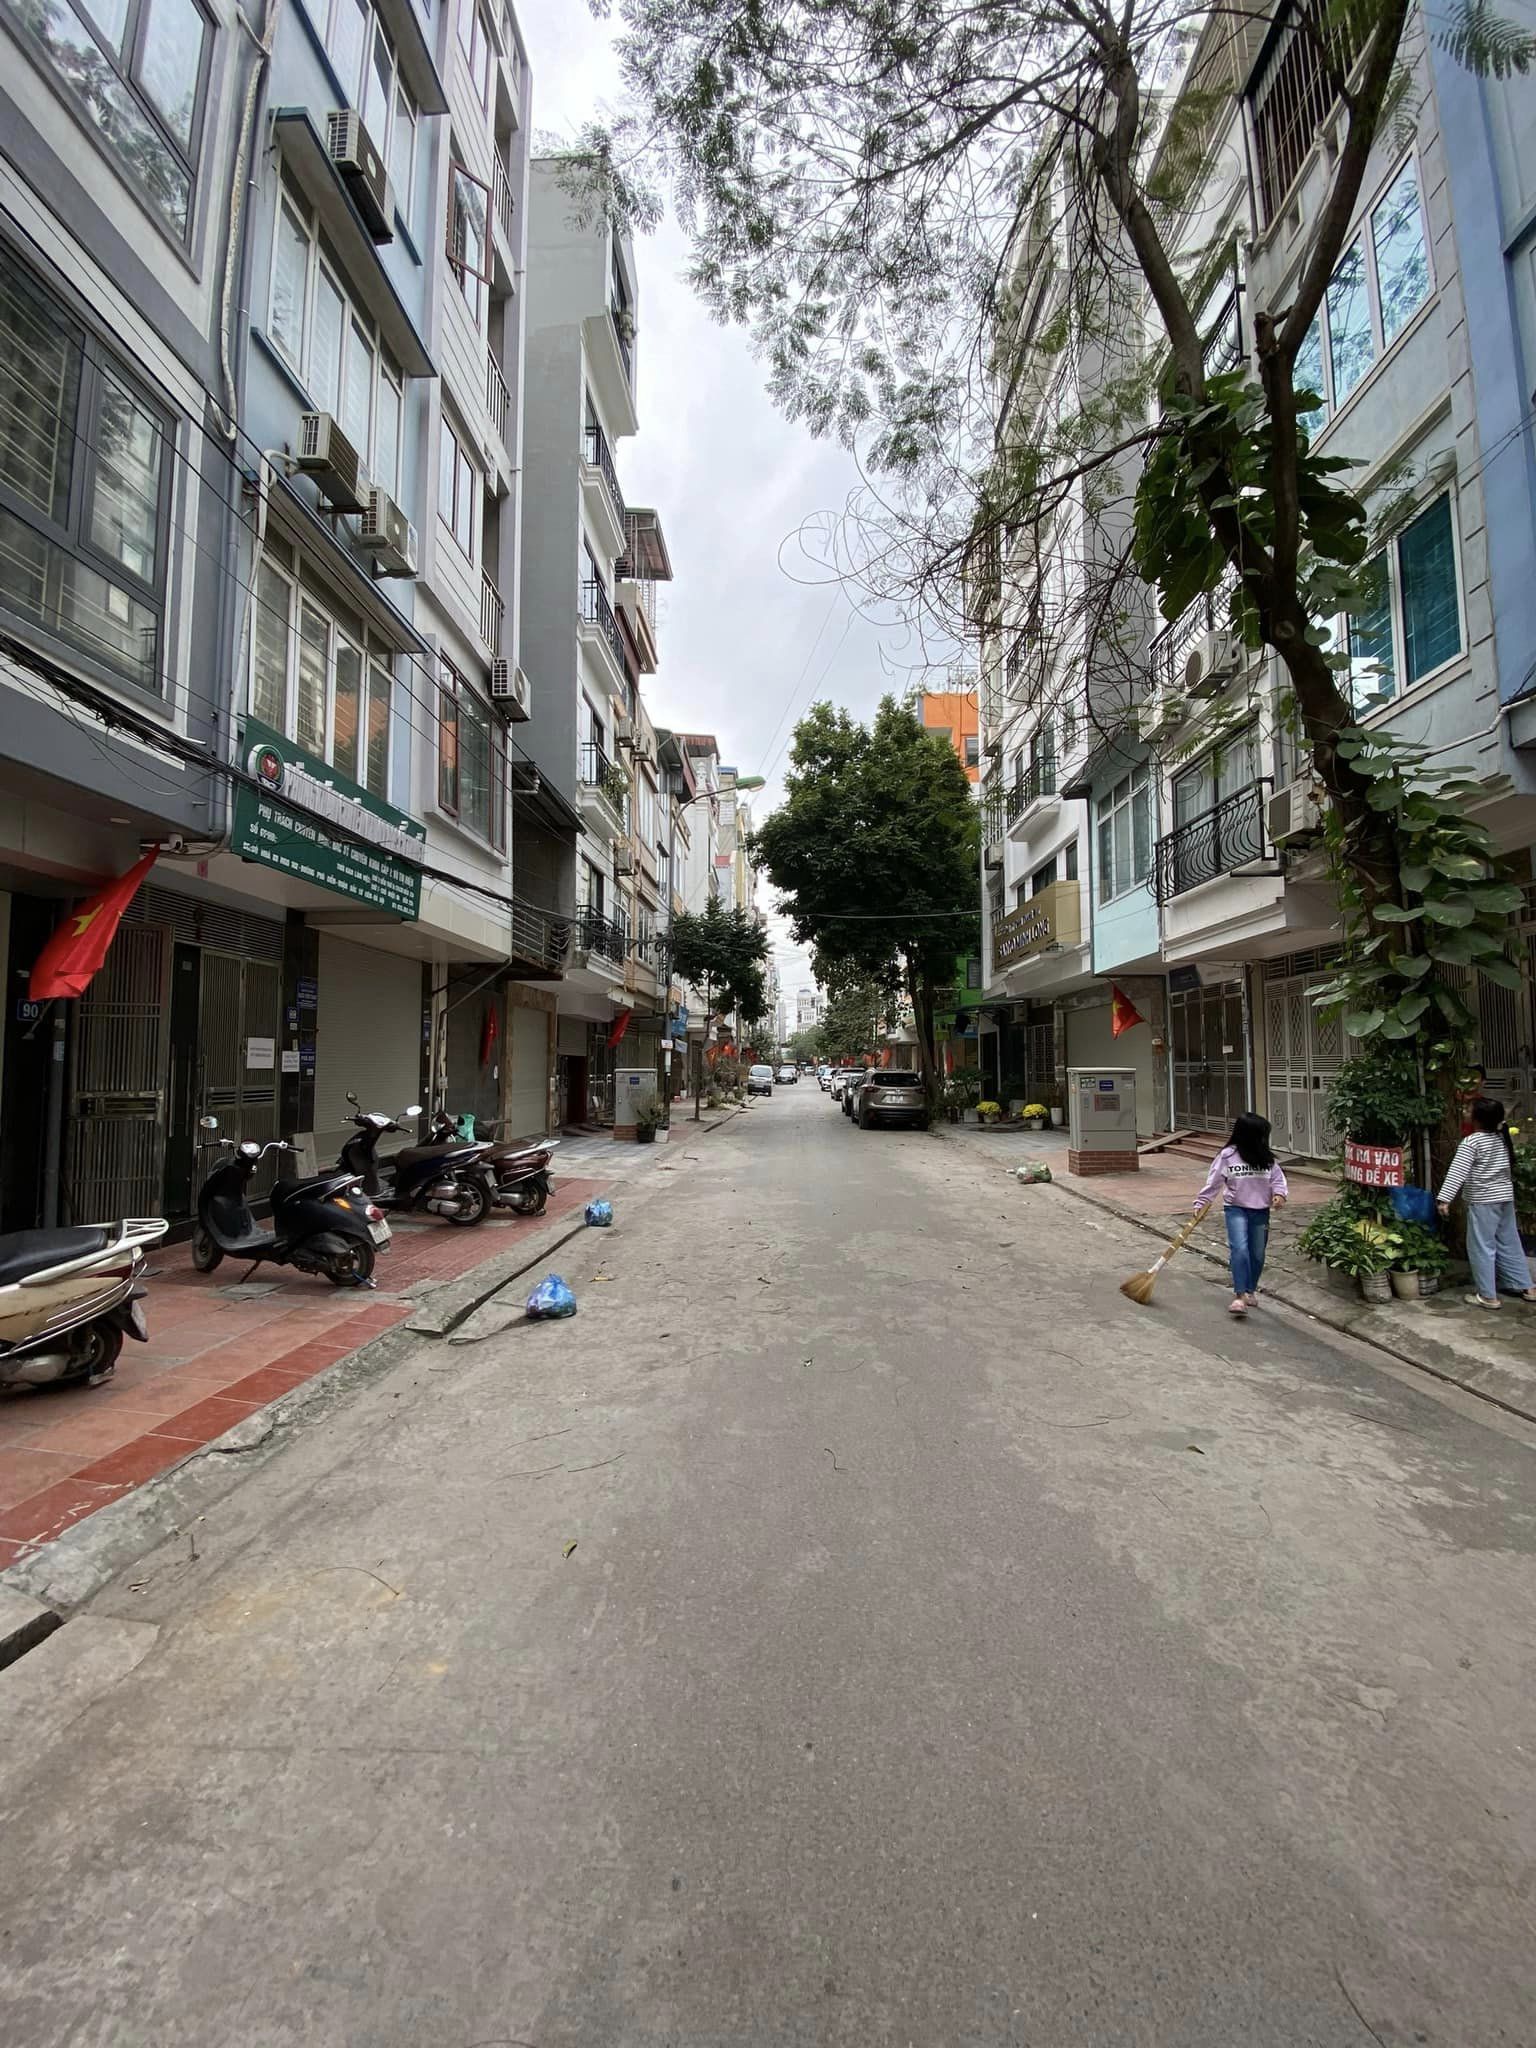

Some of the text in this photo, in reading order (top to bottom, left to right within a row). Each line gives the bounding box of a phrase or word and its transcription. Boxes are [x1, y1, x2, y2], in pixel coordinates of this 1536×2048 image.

[23, 1003, 39, 1018] 90
[1356, 1148, 1370, 1164] RA
[1374, 1149, 1399, 1167] VÀO
[1383, 1171, 1399, 1186] XE
